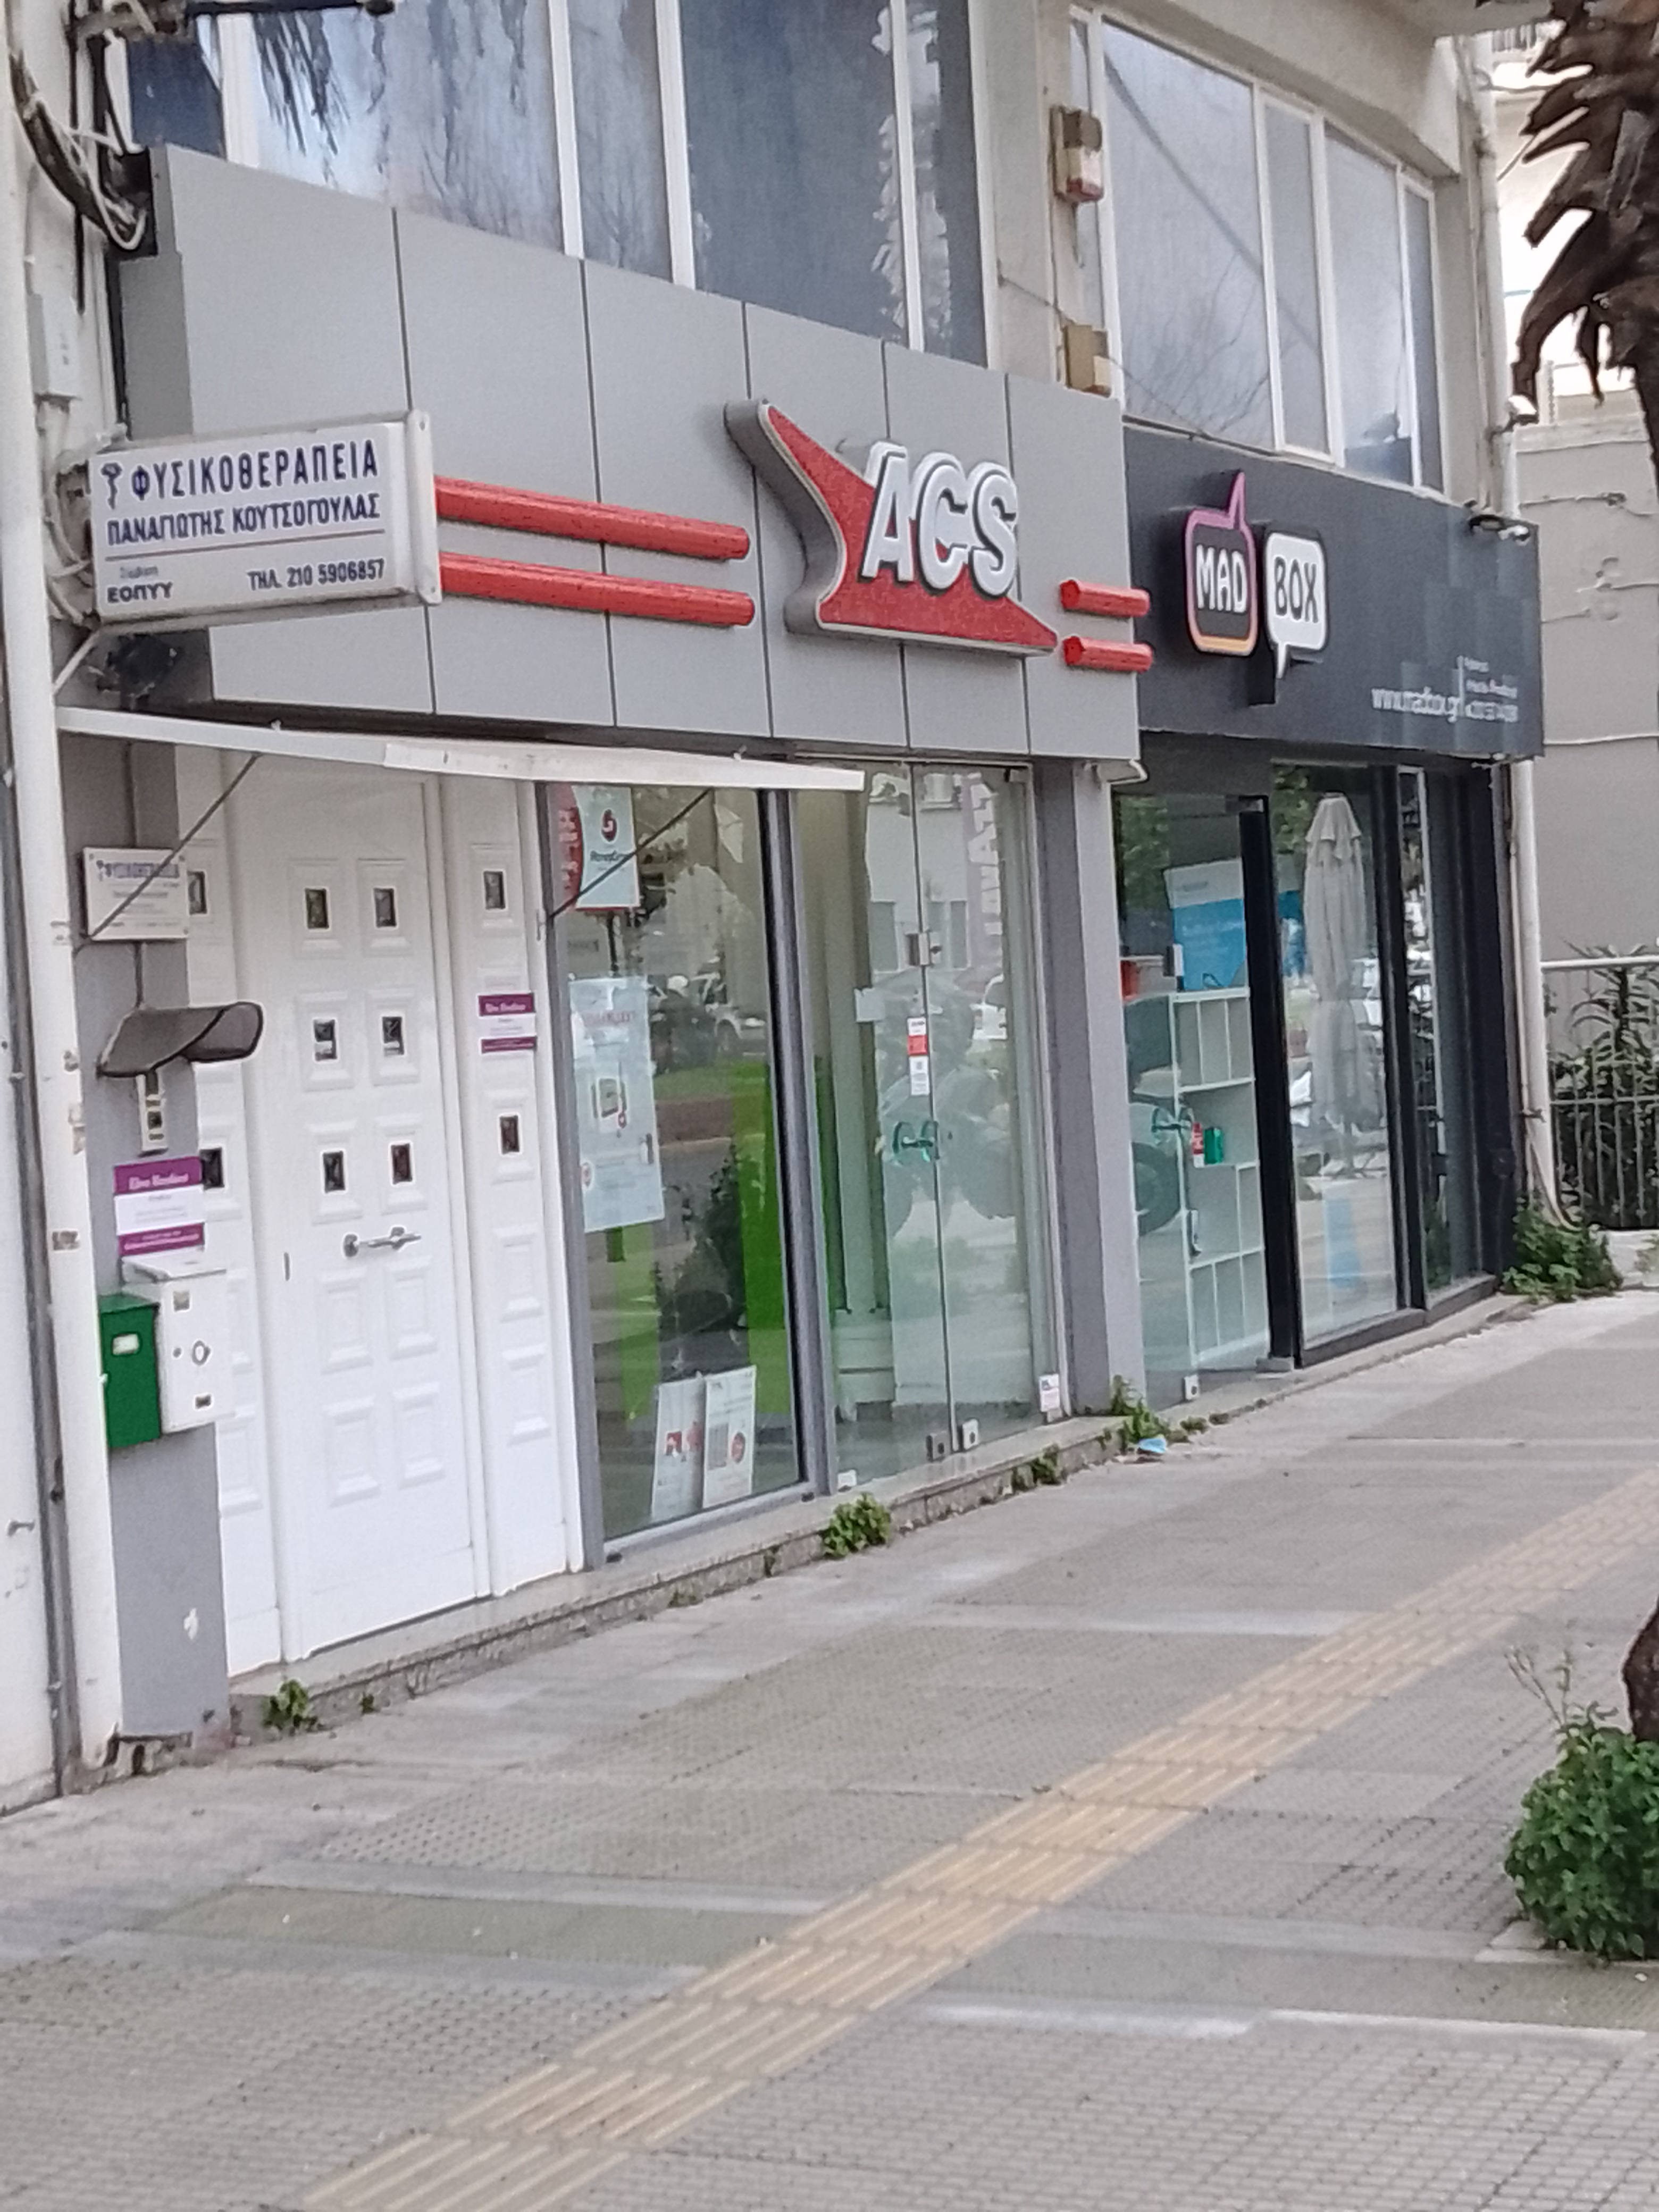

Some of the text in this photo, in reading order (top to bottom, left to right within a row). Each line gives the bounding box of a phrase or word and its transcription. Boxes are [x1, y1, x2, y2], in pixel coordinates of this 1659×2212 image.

[131, 439, 378, 501] ΦΥΣΙΚΟΘΕΡΑΠΕΙΑ
[107, 493, 381, 546] ΠΑΝΑΓΙΩΤΗΣ ΚΟΥΤΣΟΓΟΥΛΑΣ
[858, 442, 1018, 598] ACS
[107, 581, 173, 604] ΕΟΠΥΥ
[287, 565, 313, 588] 210
[317, 558, 384, 585] 5906857
[1196, 544, 1247, 613] MAD
[1274, 556, 1319, 624] BOX
